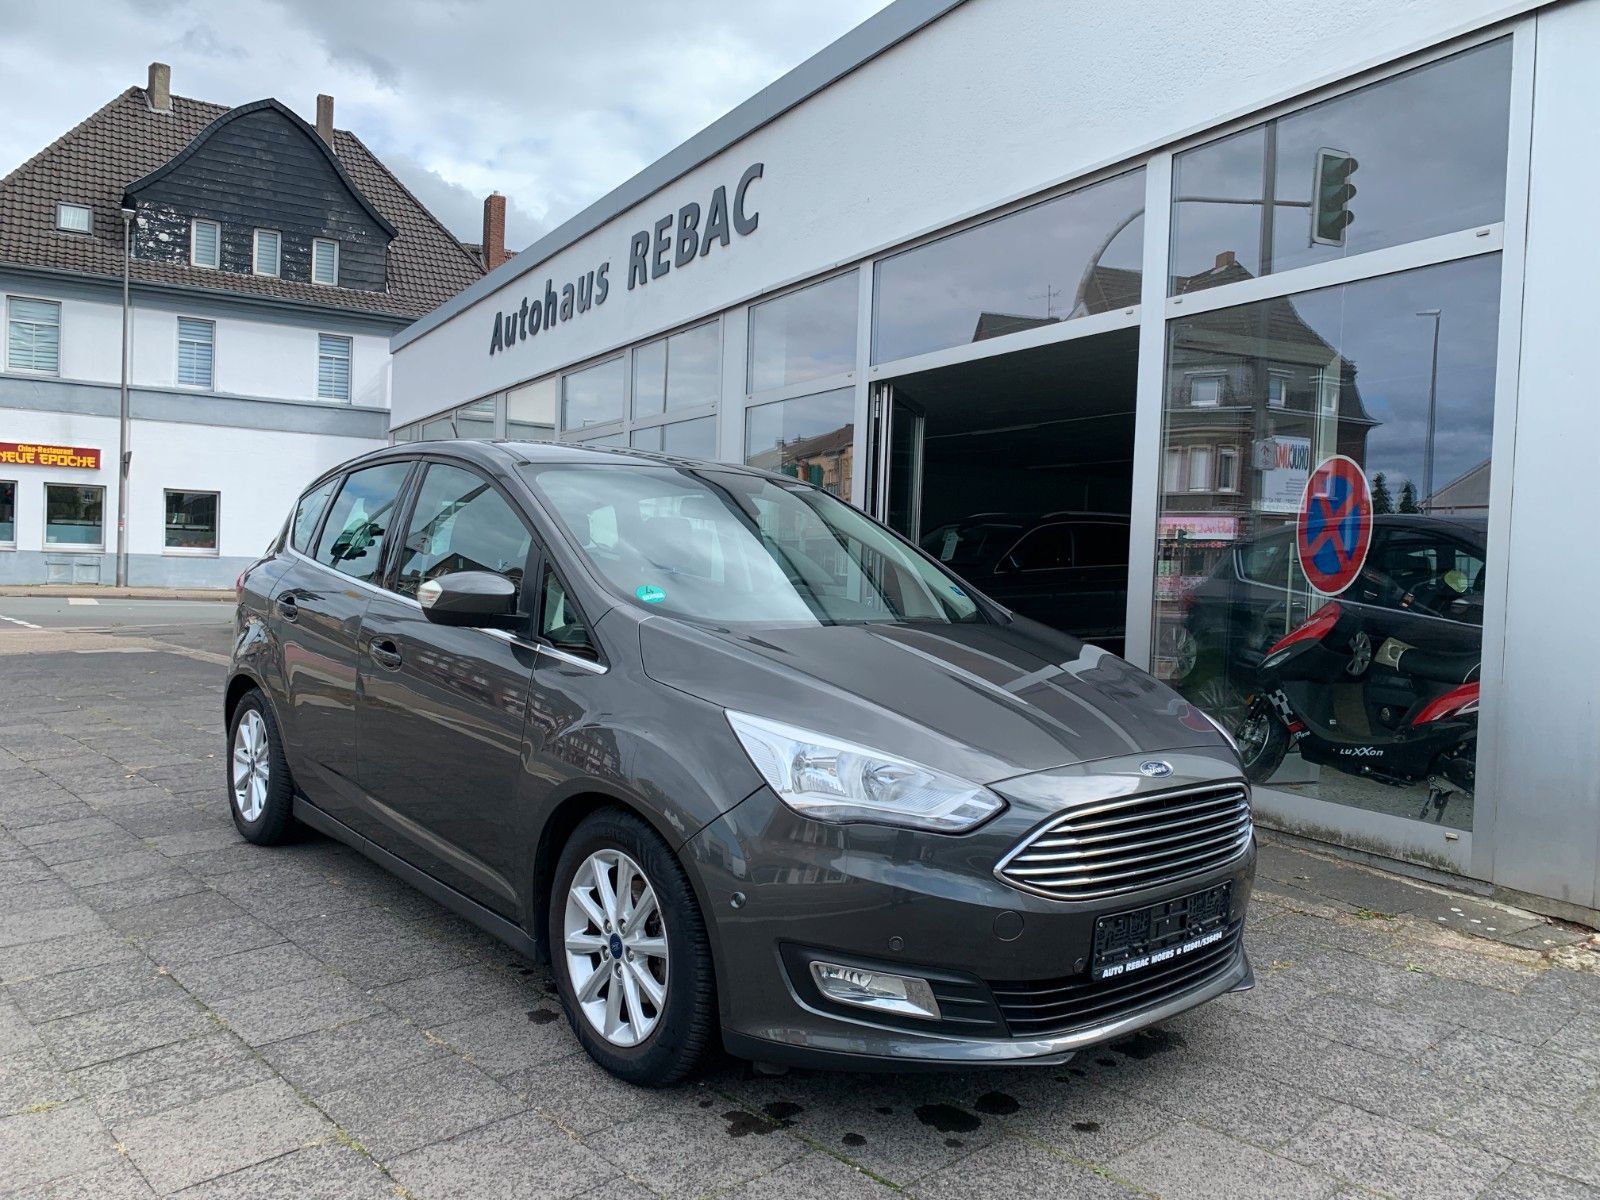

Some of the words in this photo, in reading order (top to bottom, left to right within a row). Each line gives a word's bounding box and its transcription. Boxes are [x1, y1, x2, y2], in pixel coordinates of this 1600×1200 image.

[489, 261, 610, 355] Autohaus
[627, 163, 764, 291] REBAC
[17, 445, 74, 455] China-Restaurant
[40, 454, 96, 468] EPOCHE
[1102, 966, 1124, 978] AUTO
[1126, 958, 1149, 971] REBAC
[1151, 950, 1175, 964] MOERS
